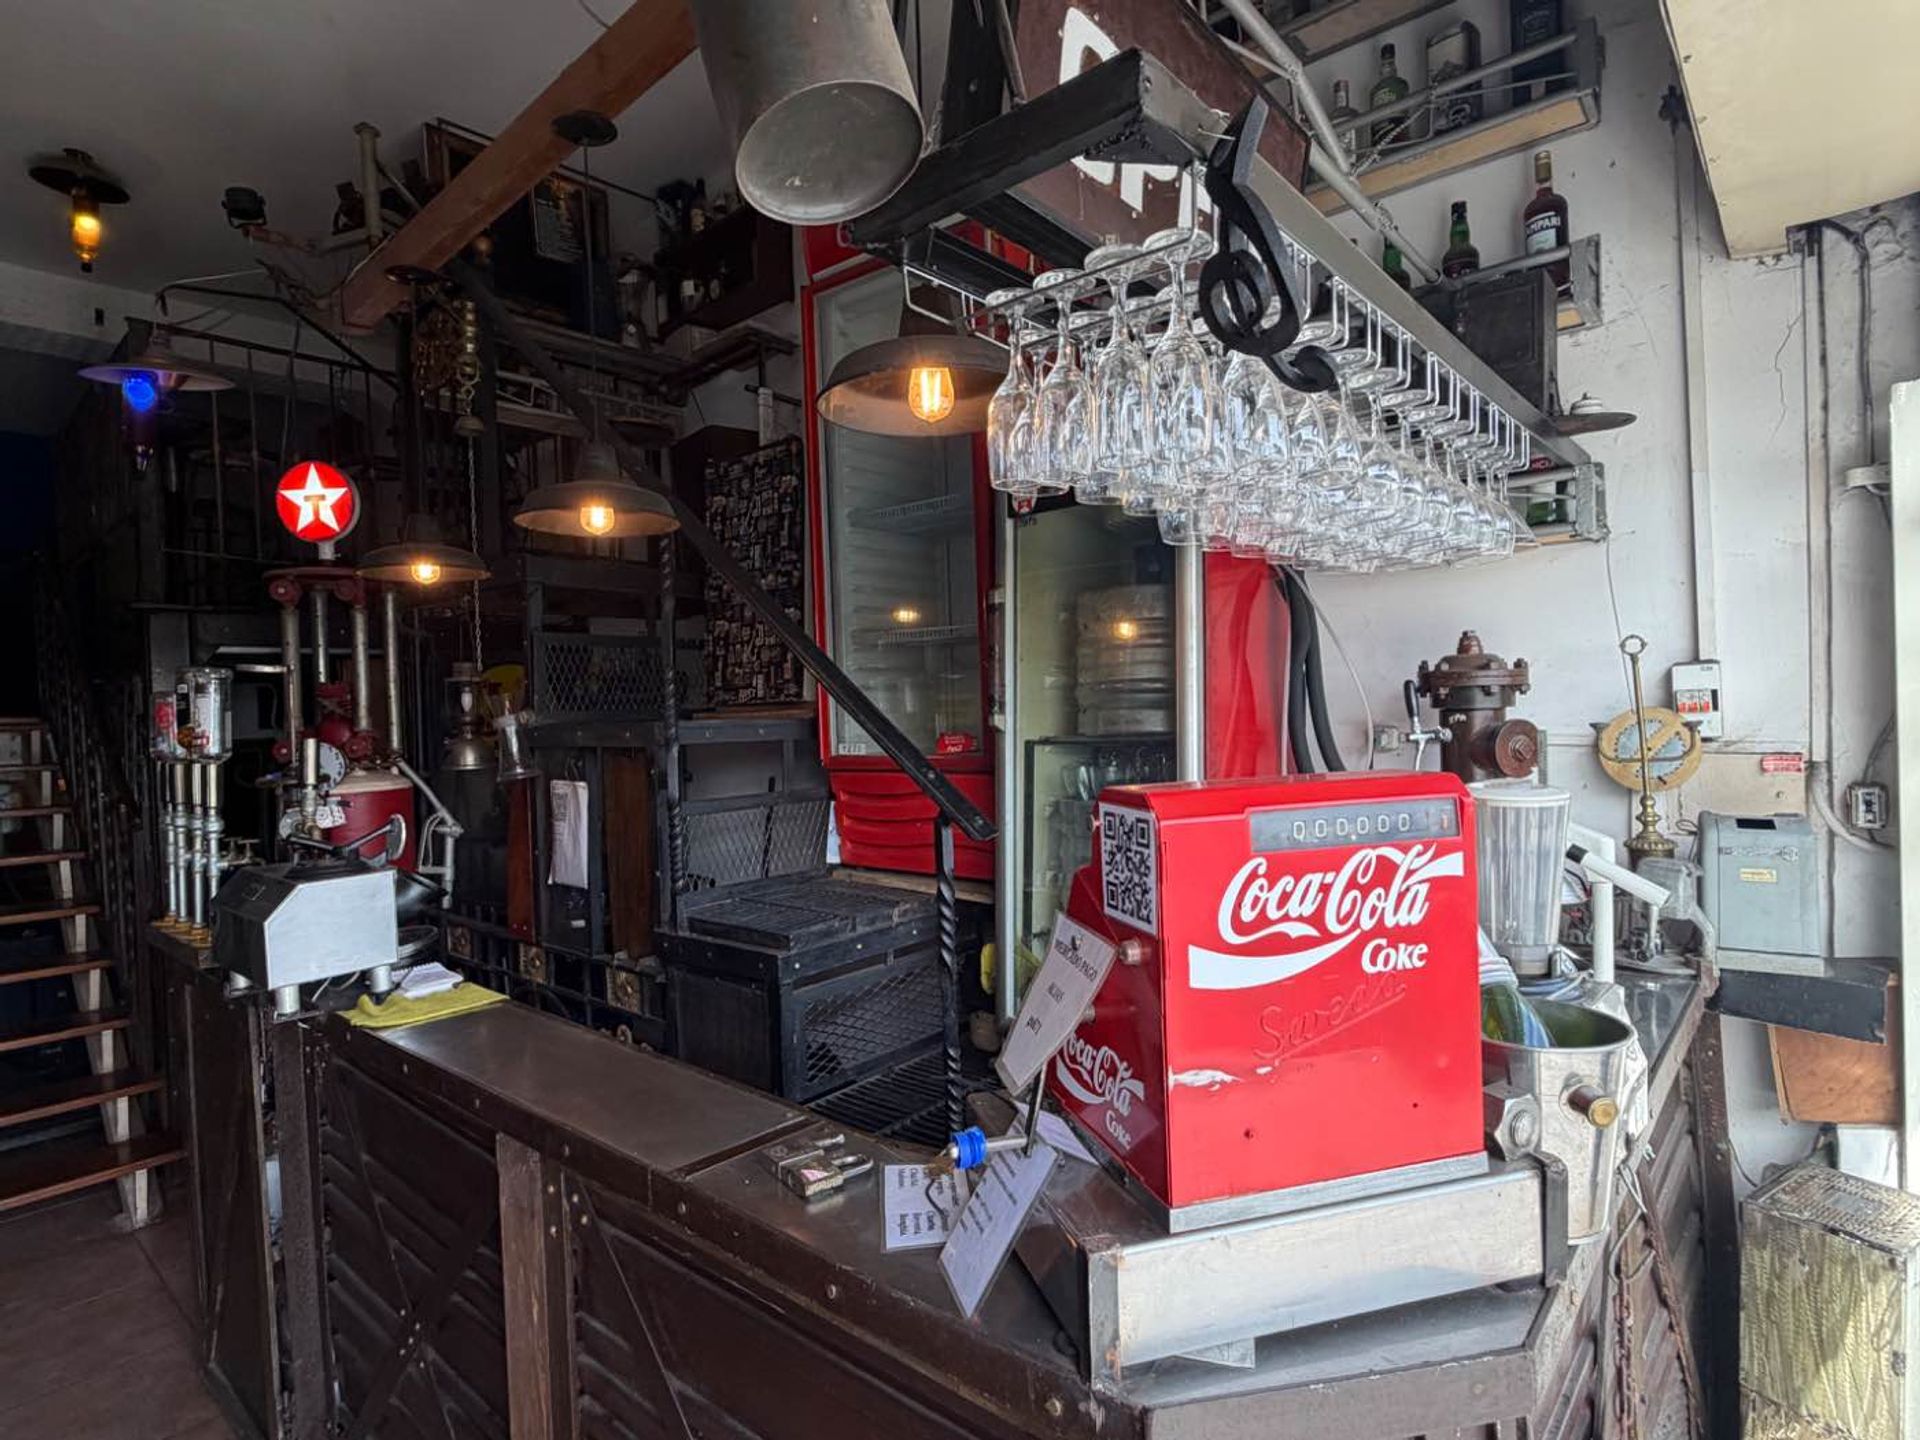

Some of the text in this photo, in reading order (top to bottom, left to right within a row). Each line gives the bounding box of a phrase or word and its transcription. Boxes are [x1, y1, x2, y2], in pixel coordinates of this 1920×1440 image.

[1527, 215, 1561, 234] MPARI
[1218, 842, 1437, 945] Coca-Cola
[1361, 938, 1429, 974] Coke
